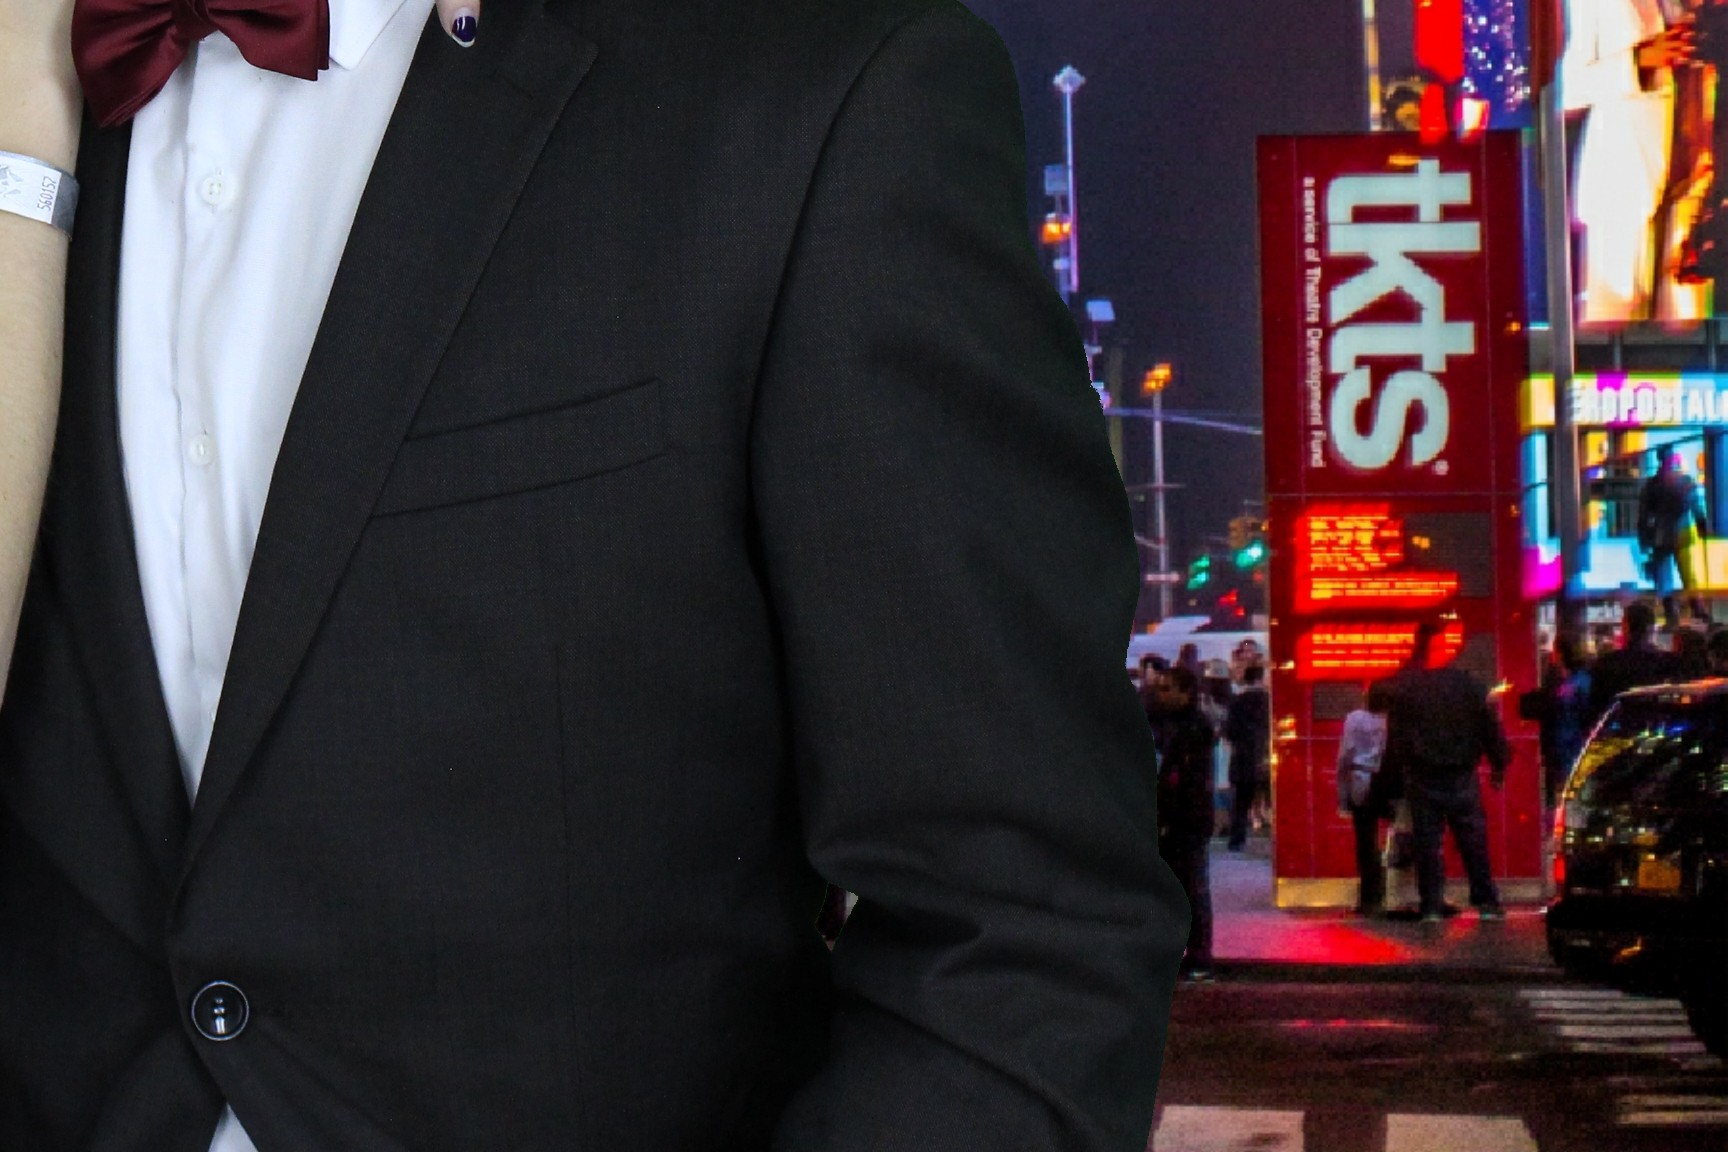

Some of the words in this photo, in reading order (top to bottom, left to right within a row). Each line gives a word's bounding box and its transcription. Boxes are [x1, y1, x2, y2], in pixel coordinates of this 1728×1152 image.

[36, 175, 58, 212] 560157
[1303, 189, 1319, 244] service
[1305, 248, 1321, 263] of
[1327, 159, 1481, 472] tkts
[1307, 329, 1323, 426] Development
[1311, 430, 1327, 468] Fund
